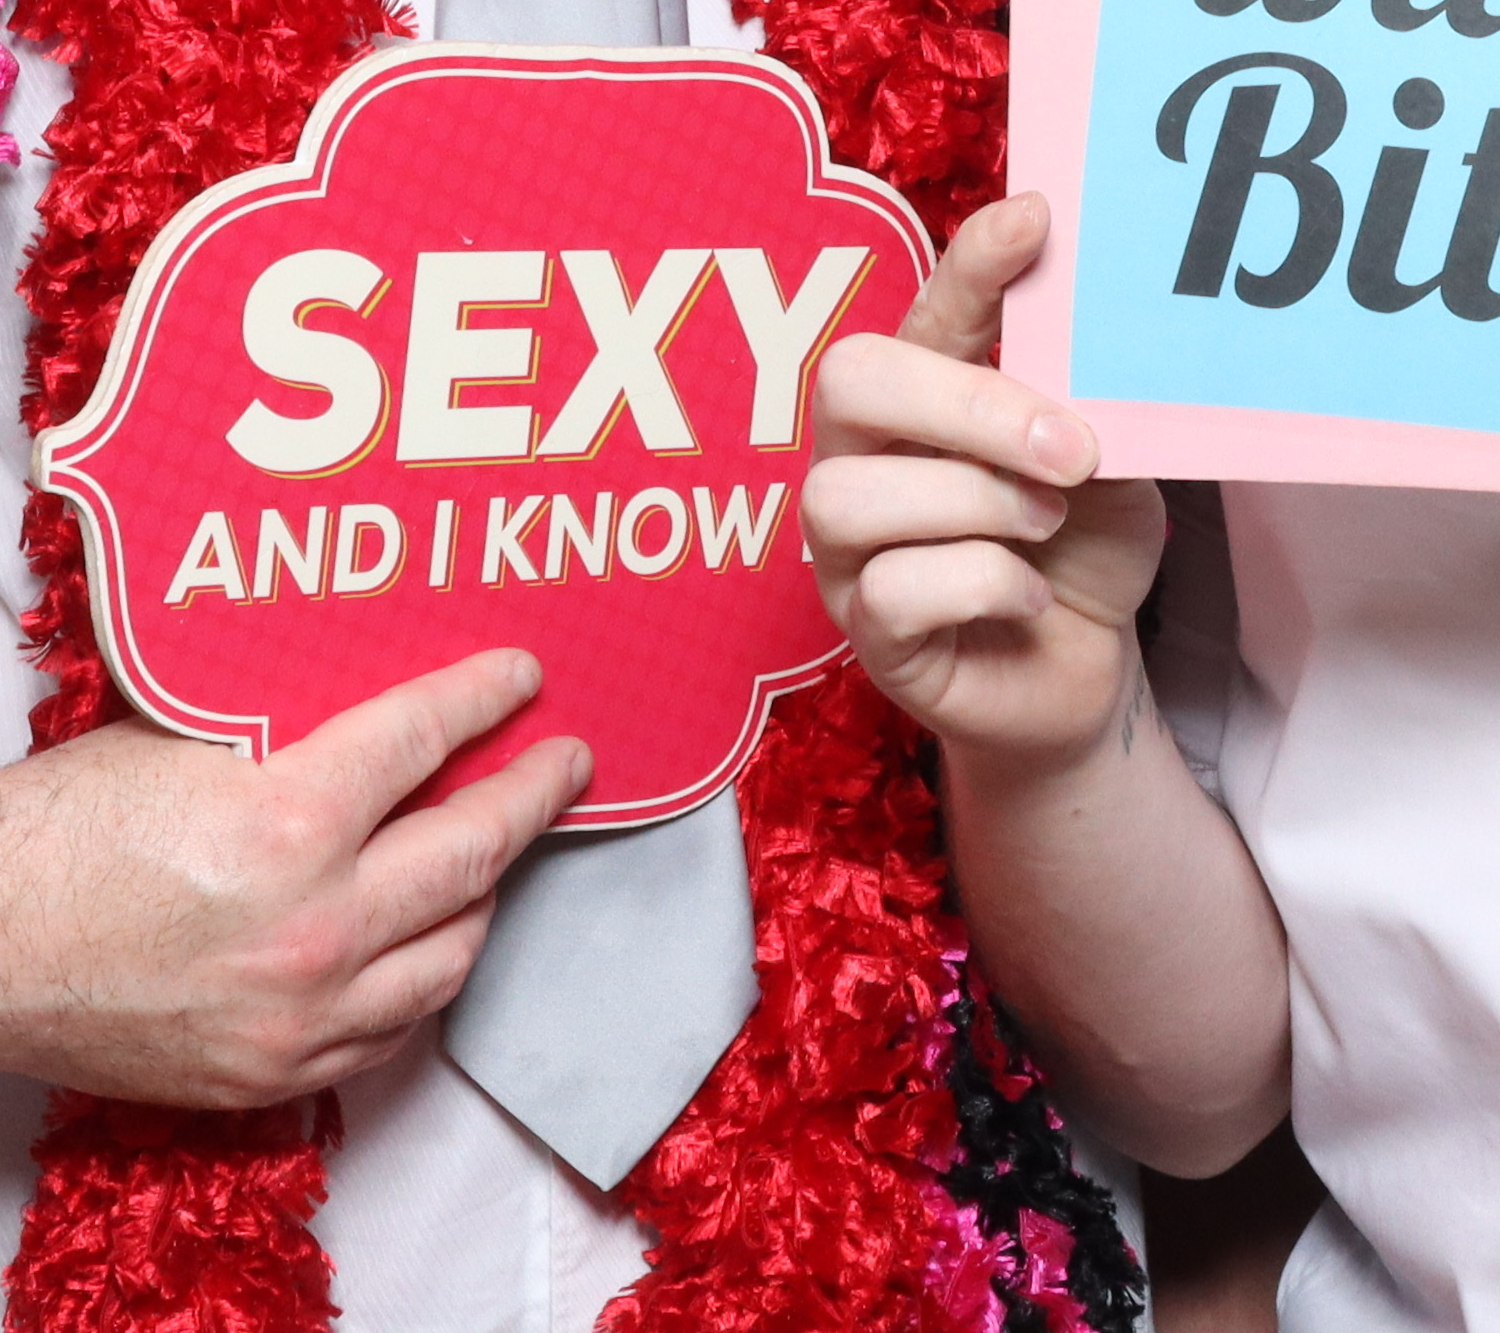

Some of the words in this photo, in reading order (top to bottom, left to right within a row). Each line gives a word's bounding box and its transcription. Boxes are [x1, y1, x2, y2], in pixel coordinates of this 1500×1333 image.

[225, 245, 876, 479] SEXY
[164, 502, 405, 608] AND
[429, 500, 456, 591] I
[481, 482, 790, 587] KNOW
